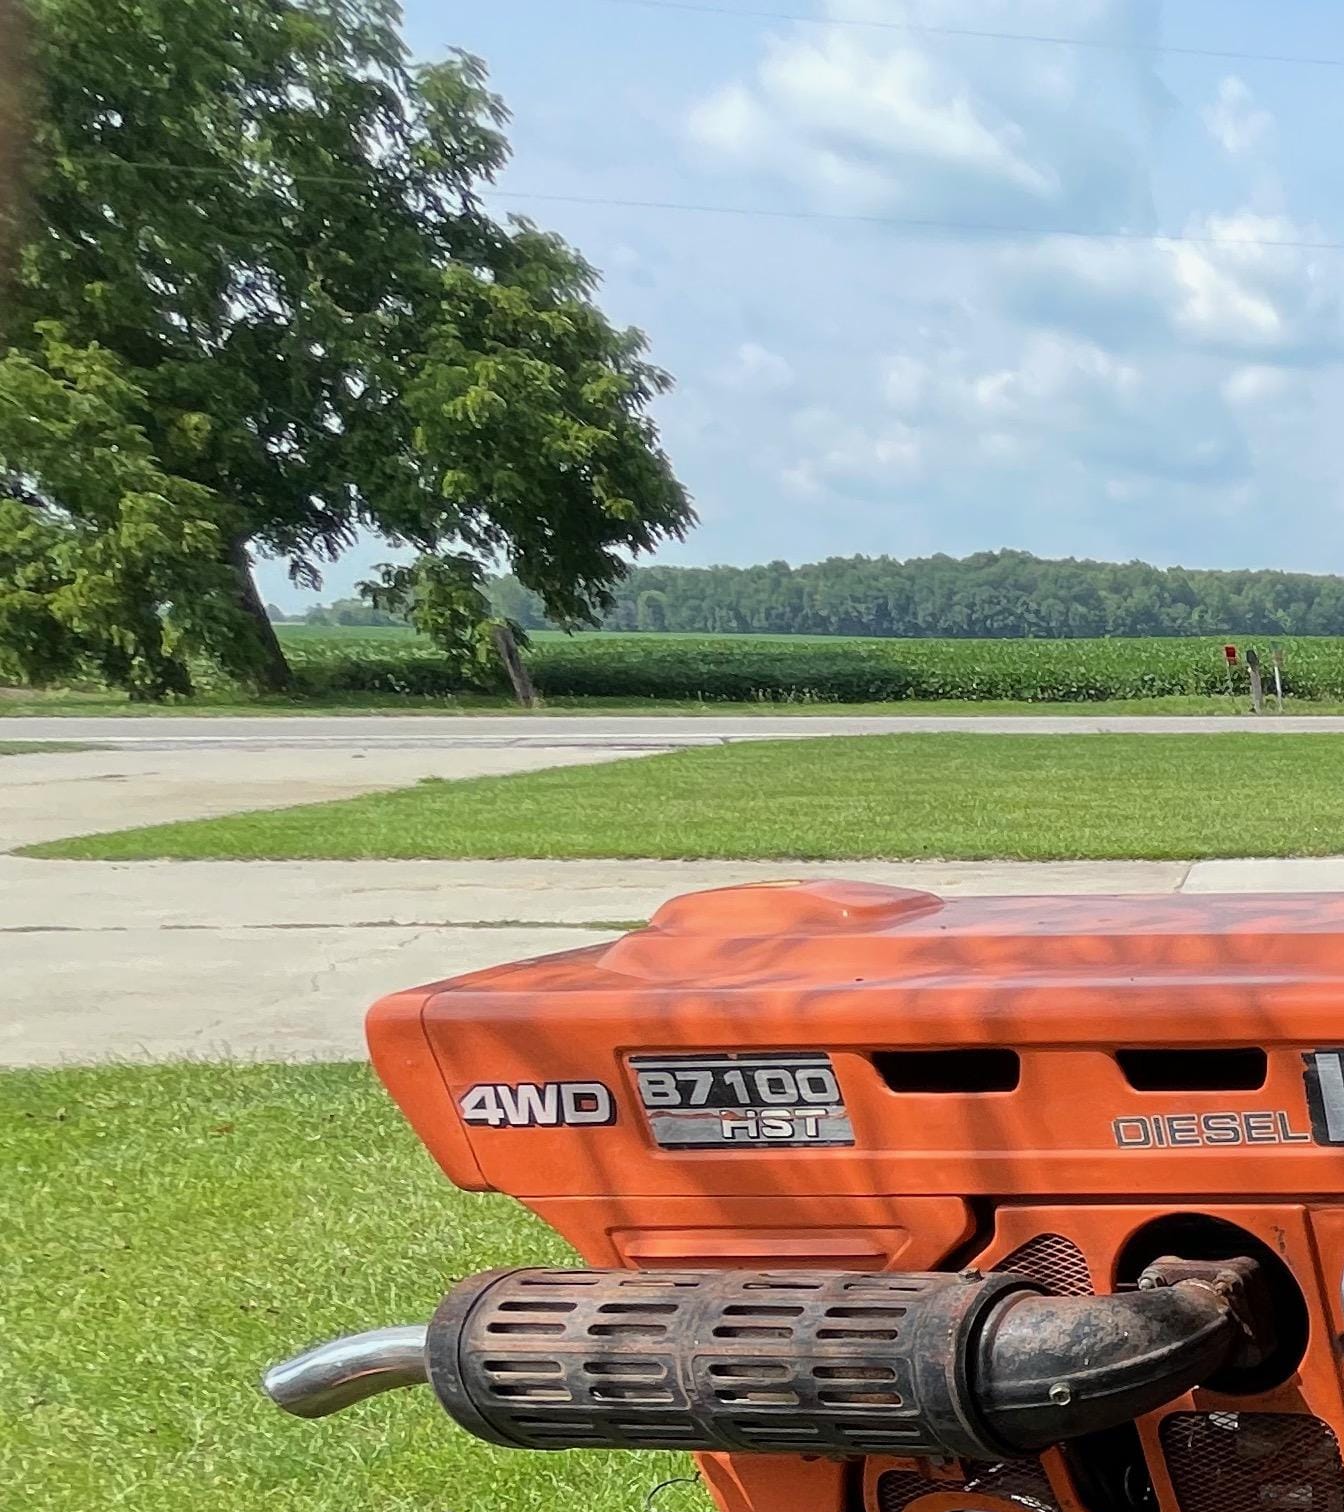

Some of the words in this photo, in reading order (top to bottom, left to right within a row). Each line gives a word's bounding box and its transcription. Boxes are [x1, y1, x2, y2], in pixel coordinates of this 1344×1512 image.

[460, 1082, 617, 1127] 4WD
[640, 1068, 842, 1106] B7100
[720, 1109, 828, 1139] HST
[1113, 1111, 1310, 1148] DIESEL
